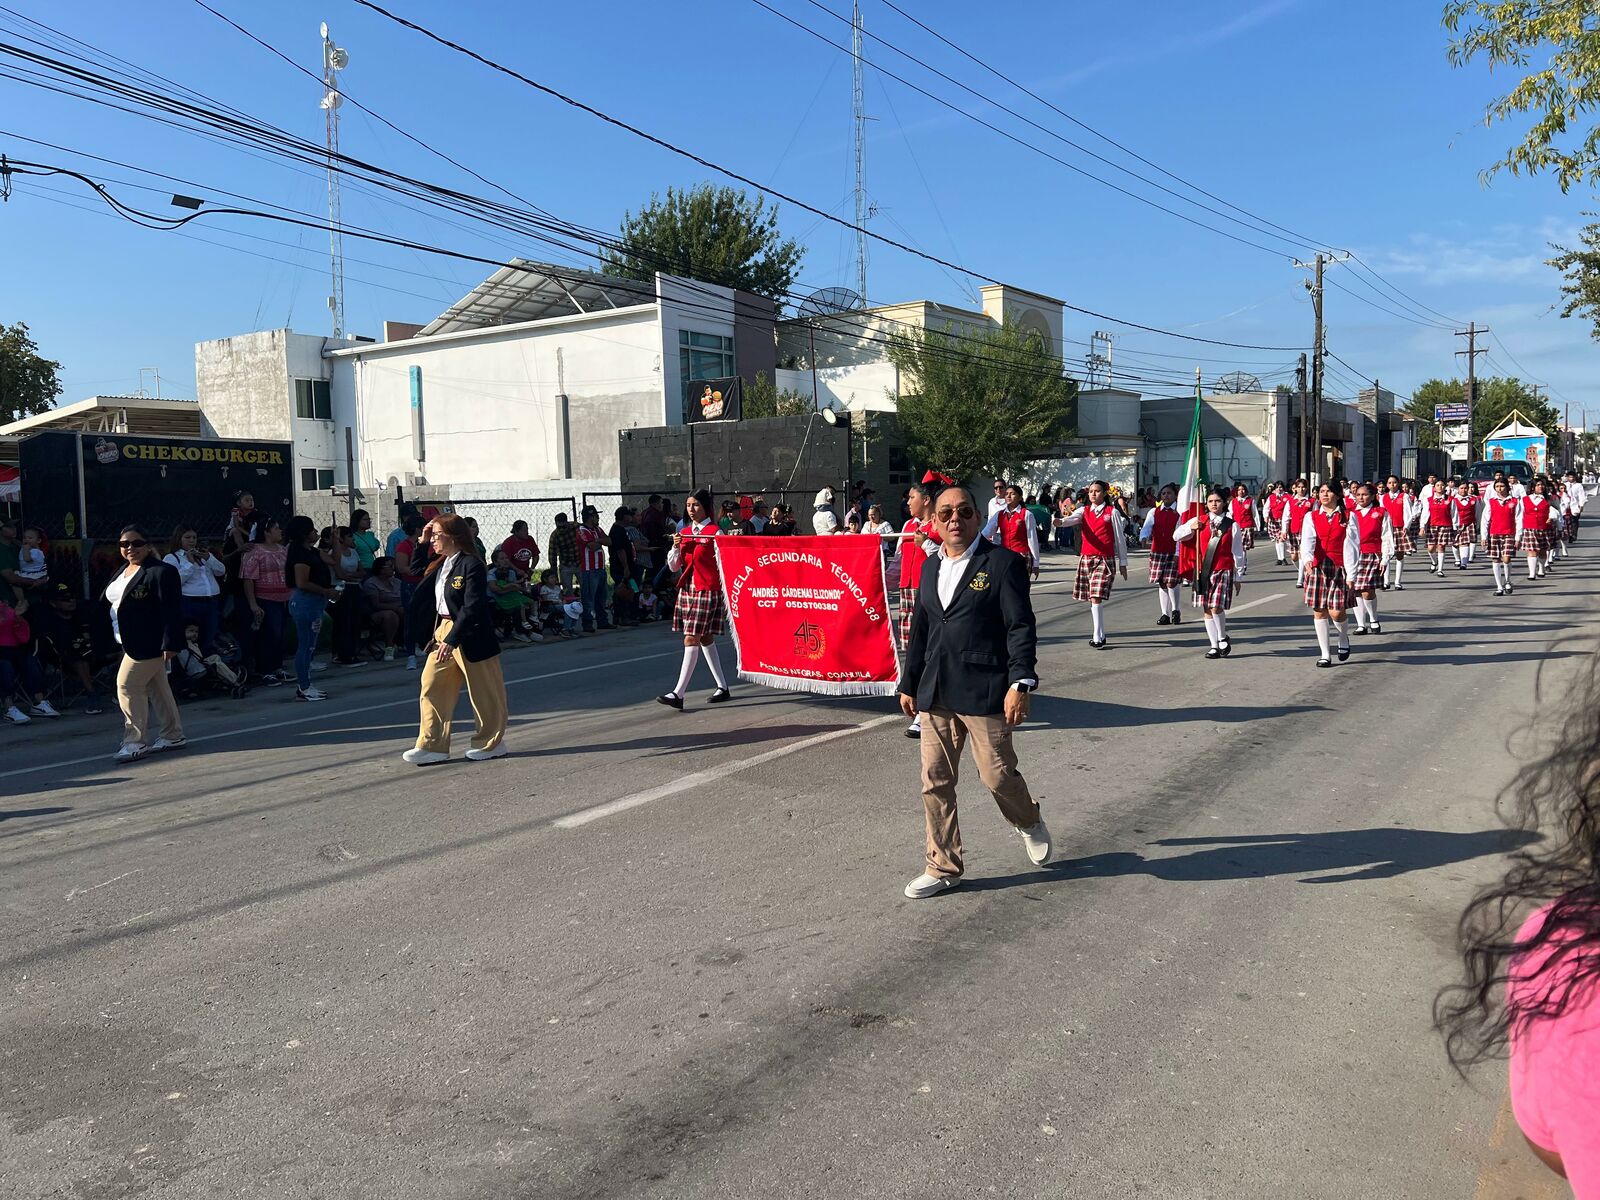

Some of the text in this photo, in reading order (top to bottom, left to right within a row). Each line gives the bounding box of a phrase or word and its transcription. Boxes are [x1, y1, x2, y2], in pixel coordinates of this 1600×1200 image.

[122, 444, 283, 464] CHEKOBURGER
[731, 552, 880, 621] ESCUELA SECUNDARIA TÉCNICA 38
[781, 584, 813, 599] CÁRDENAS
[757, 600, 839, 612] CCT 05DST0038Q
[794, 618, 821, 652] 45
[827, 671, 871, 679] COAHUILA
